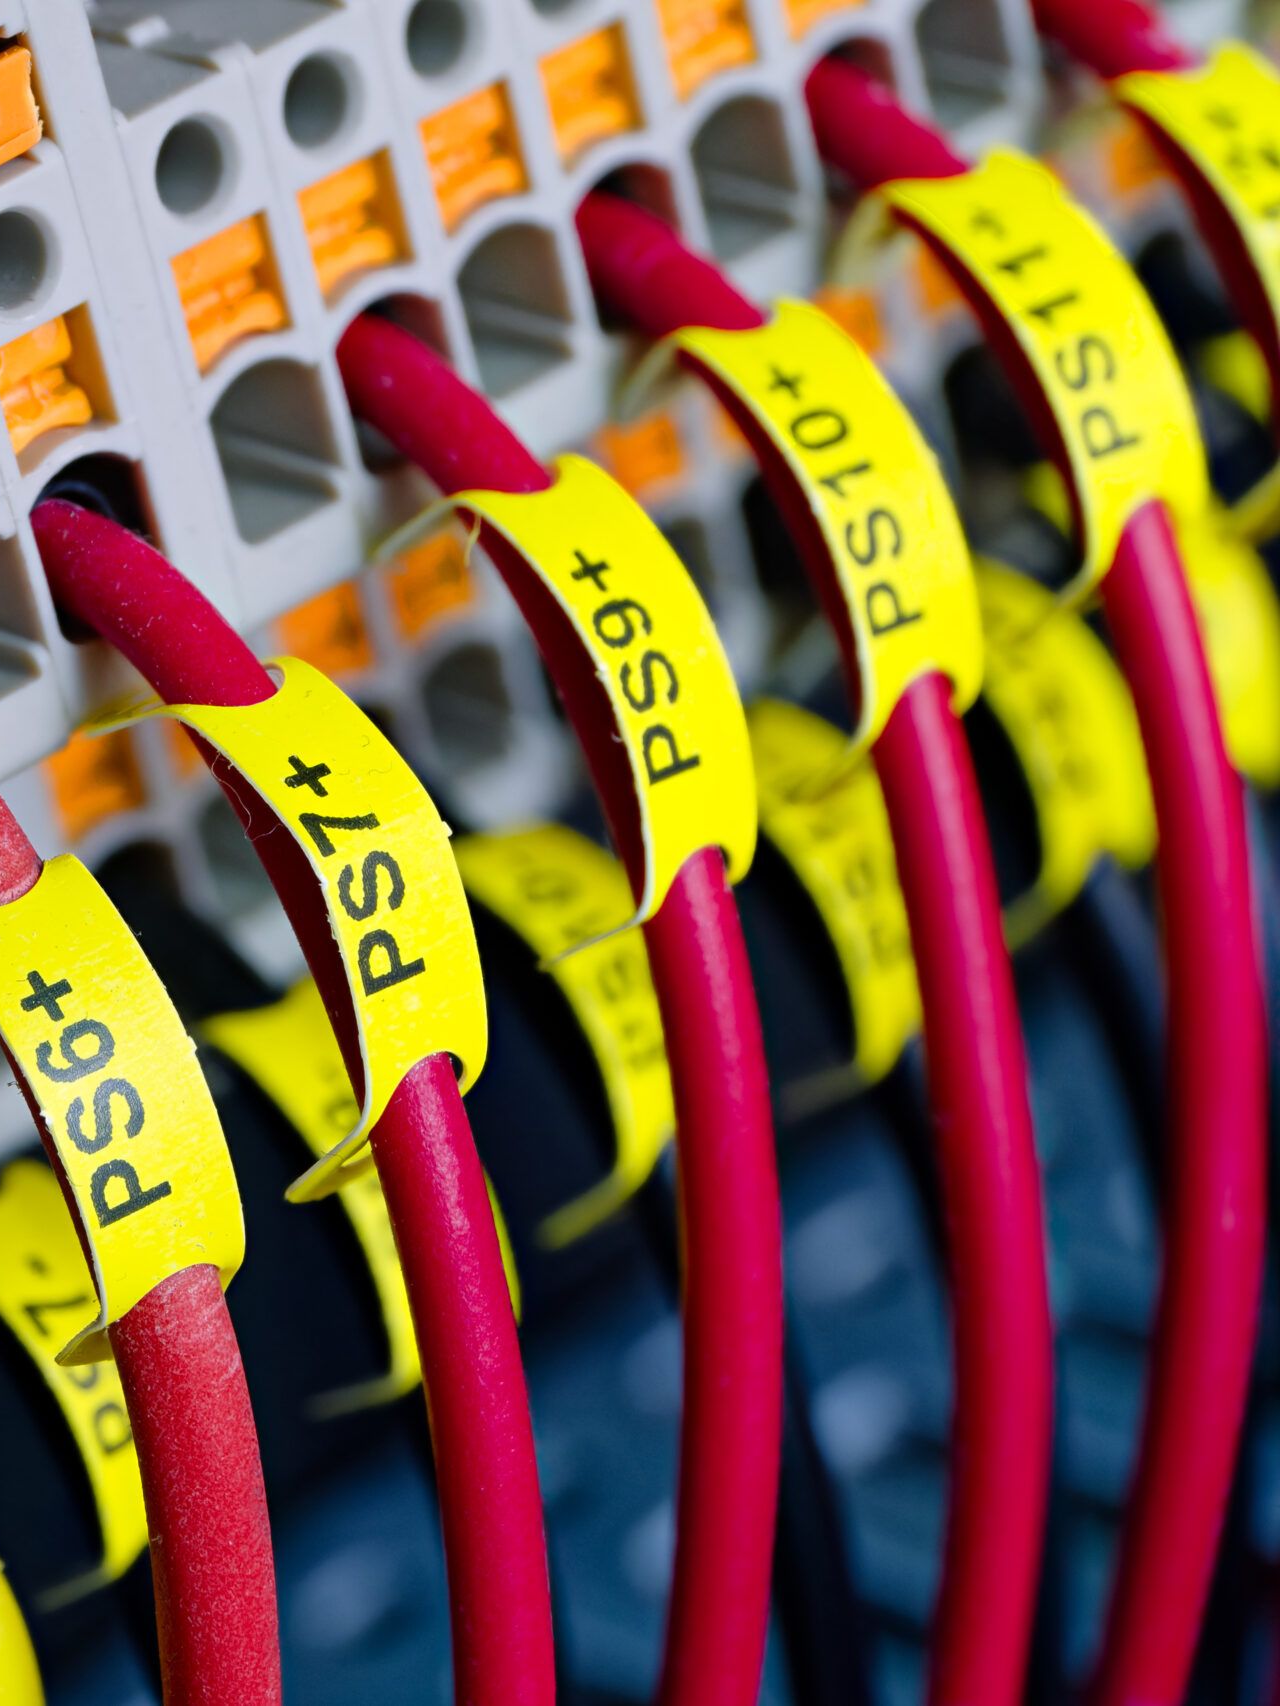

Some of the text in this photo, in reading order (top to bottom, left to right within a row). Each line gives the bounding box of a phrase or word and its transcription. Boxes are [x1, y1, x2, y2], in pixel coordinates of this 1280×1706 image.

[766, 362, 923, 636] PS10+
[570, 549, 701, 786] PS9+
[284, 754, 427, 997] PS7+
[20, 969, 173, 1229] PS6+
